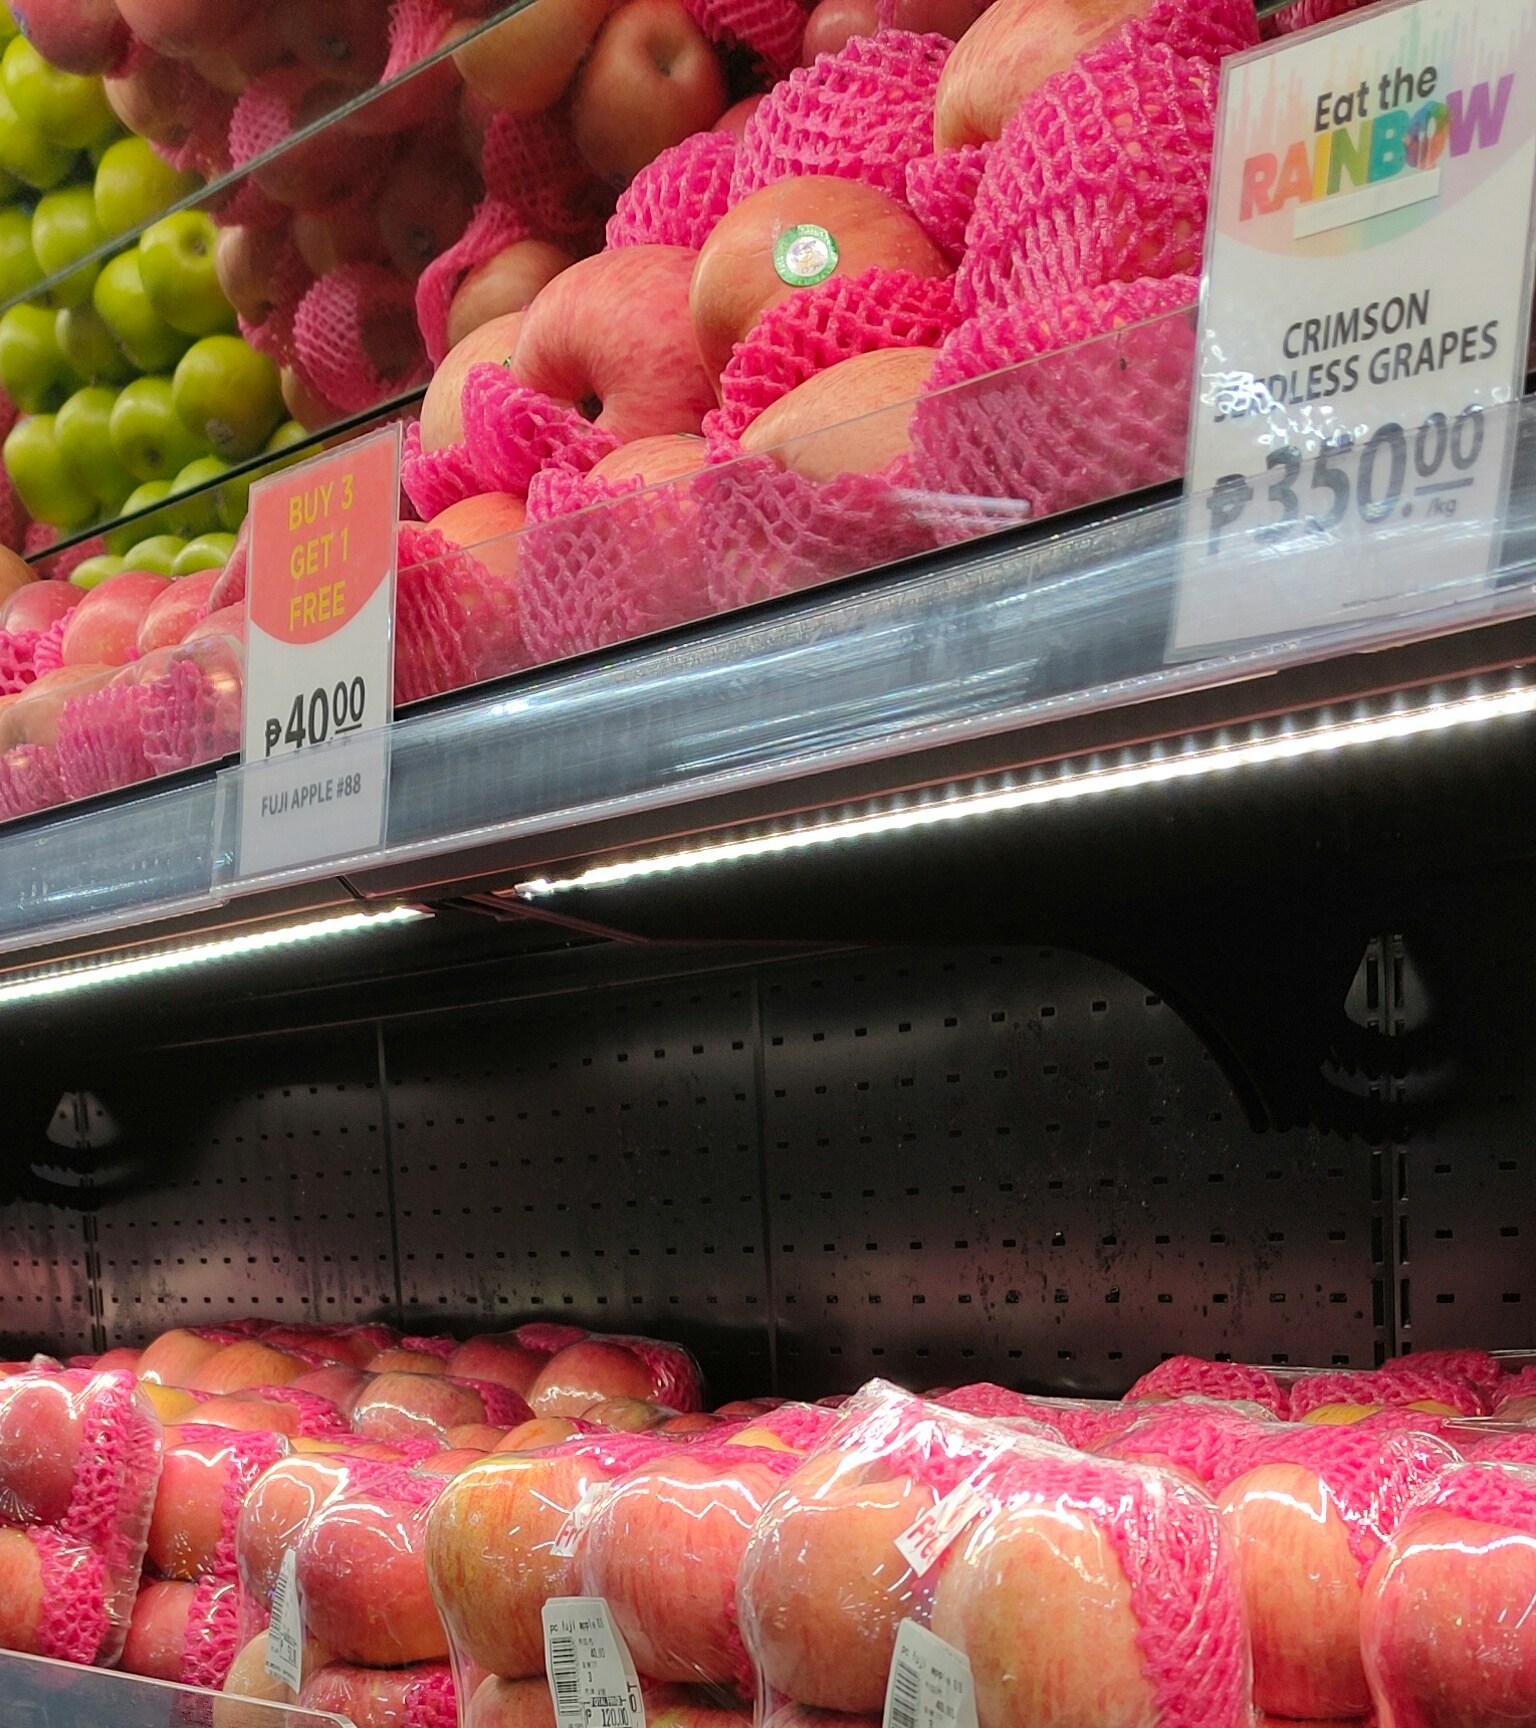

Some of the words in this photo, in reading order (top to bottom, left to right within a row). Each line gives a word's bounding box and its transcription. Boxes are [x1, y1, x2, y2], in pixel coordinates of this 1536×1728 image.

[1314, 89, 1370, 134] Eat
[1378, 65, 1438, 112] the
[1239, 73, 1514, 222] RAINBOW
[1282, 290, 1431, 360] CRIMSON
[1369, 320, 1499, 386] GRAPES
[288, 483, 334, 532] BUY
[341, 474, 354, 510] 3
[289, 534, 333, 580] GET
[340, 530, 349, 561] 1
[288, 580, 346, 632] FREE
[261, 784, 288, 817] FUJI
[291, 778, 333, 810] APPLE
[336, 771, 362, 798] #88
